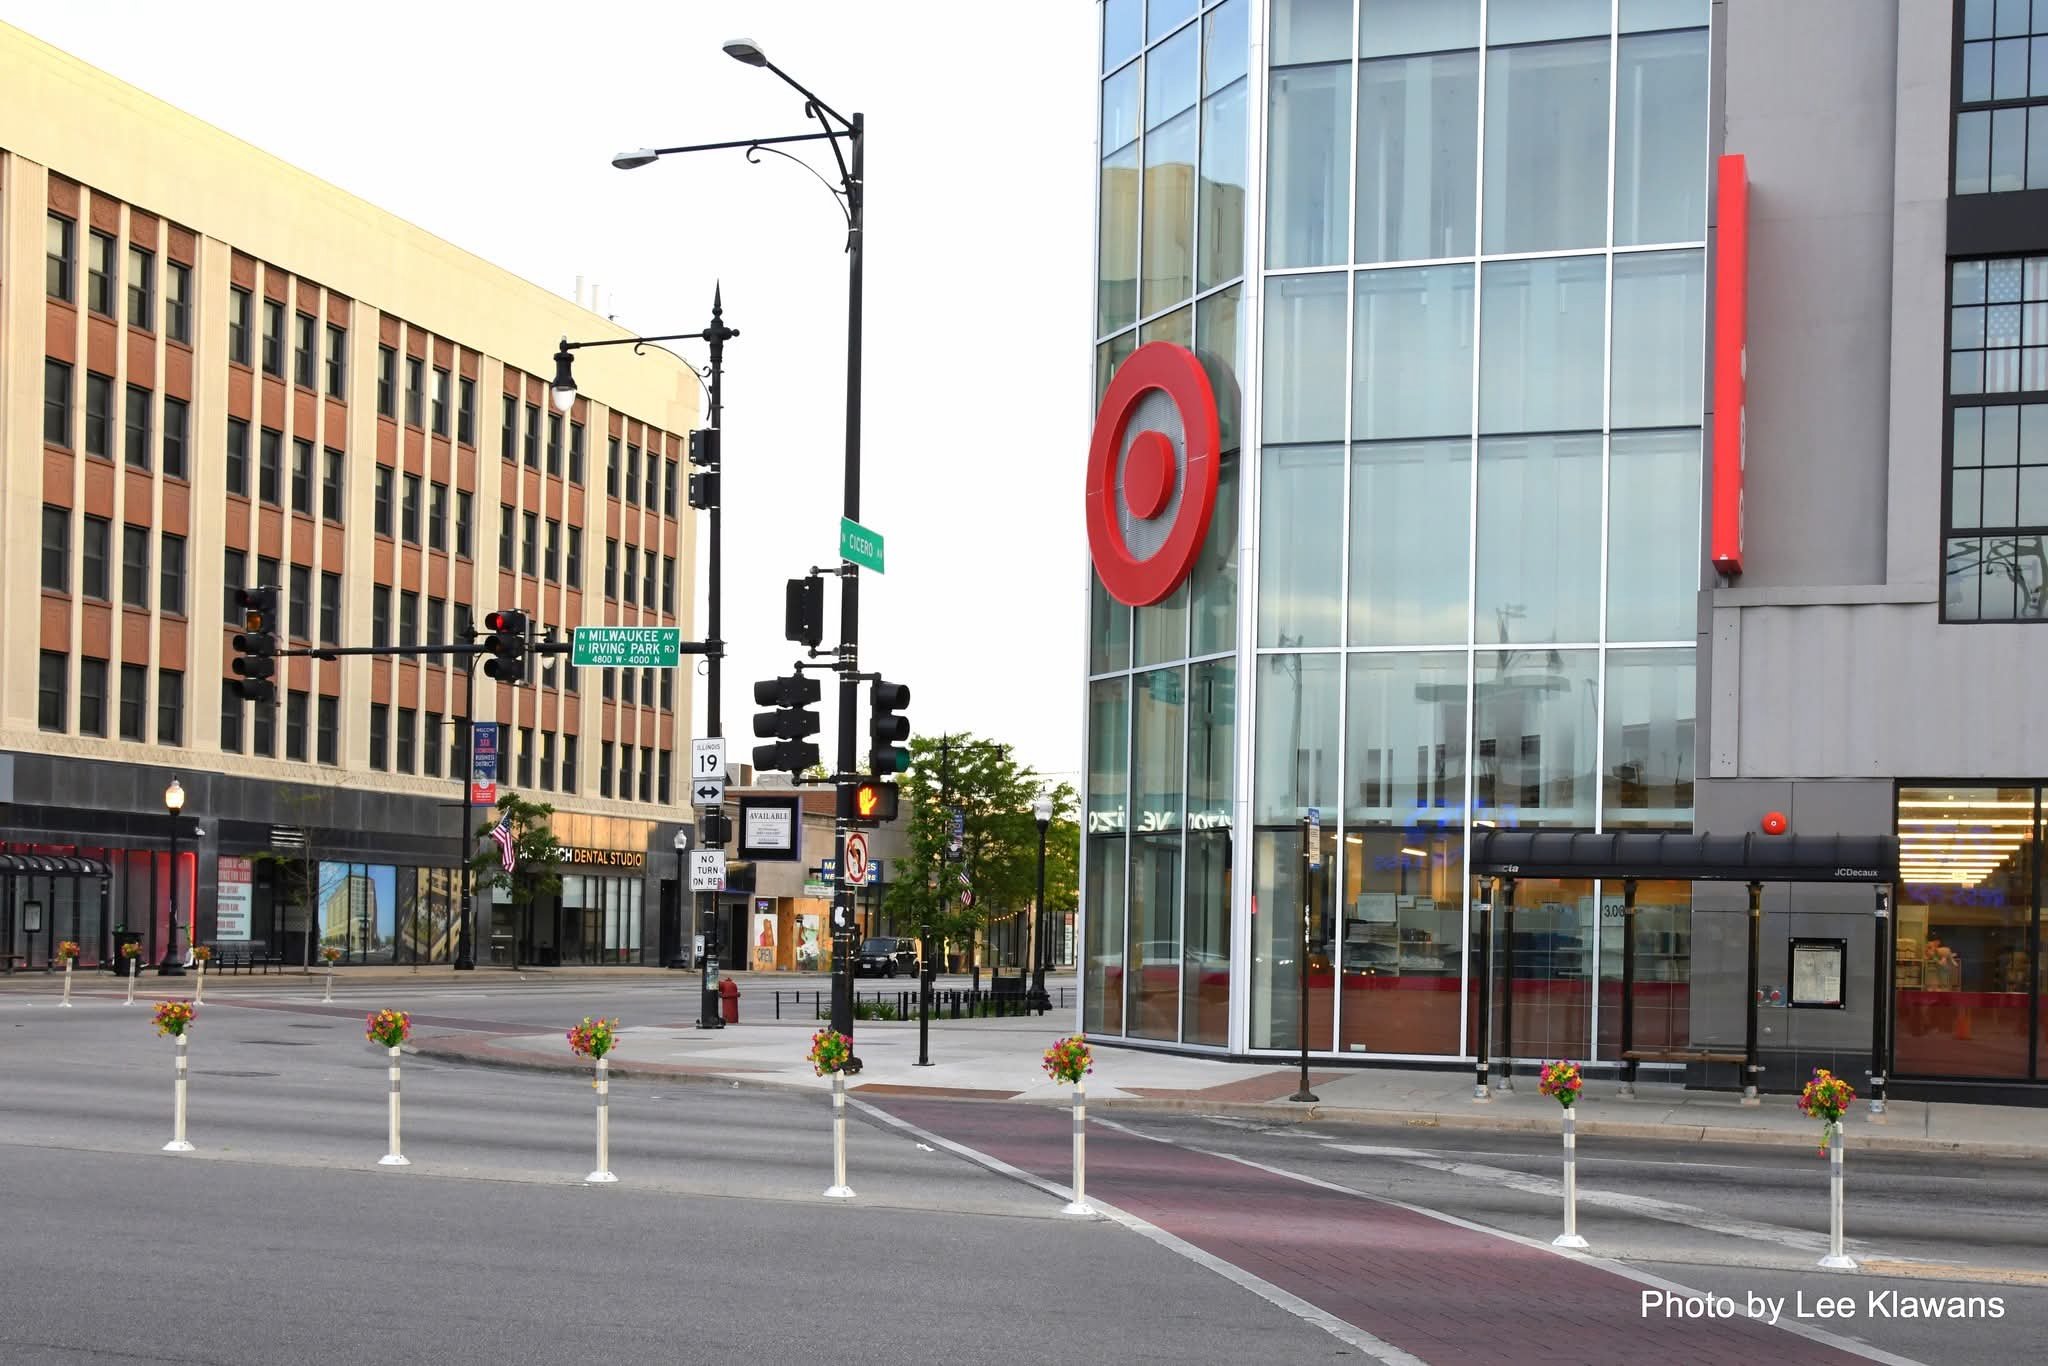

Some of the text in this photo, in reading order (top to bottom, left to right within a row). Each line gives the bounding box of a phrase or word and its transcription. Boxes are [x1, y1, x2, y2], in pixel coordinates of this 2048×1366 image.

[850, 533, 874, 559] CICERO
[579, 630, 674, 642] N MILWAUKEE AV
[588, 643, 625, 655] IRVING
[630, 644, 660, 655] PARK
[664, 644, 675, 653] RD
[592, 655, 612, 664] 4800
[654, 655, 660, 664] N
[700, 754, 717, 773] 19
[750, 812, 787, 820] AVAILABLE
[574, 849, 608, 865] DENTAL
[610, 851, 642, 867] STUDIO
[701, 855, 714, 863] NO
[698, 866, 718, 874] TURN
[1834, 868, 1878, 877] JCDecaux
[693, 877, 703, 886] ON
